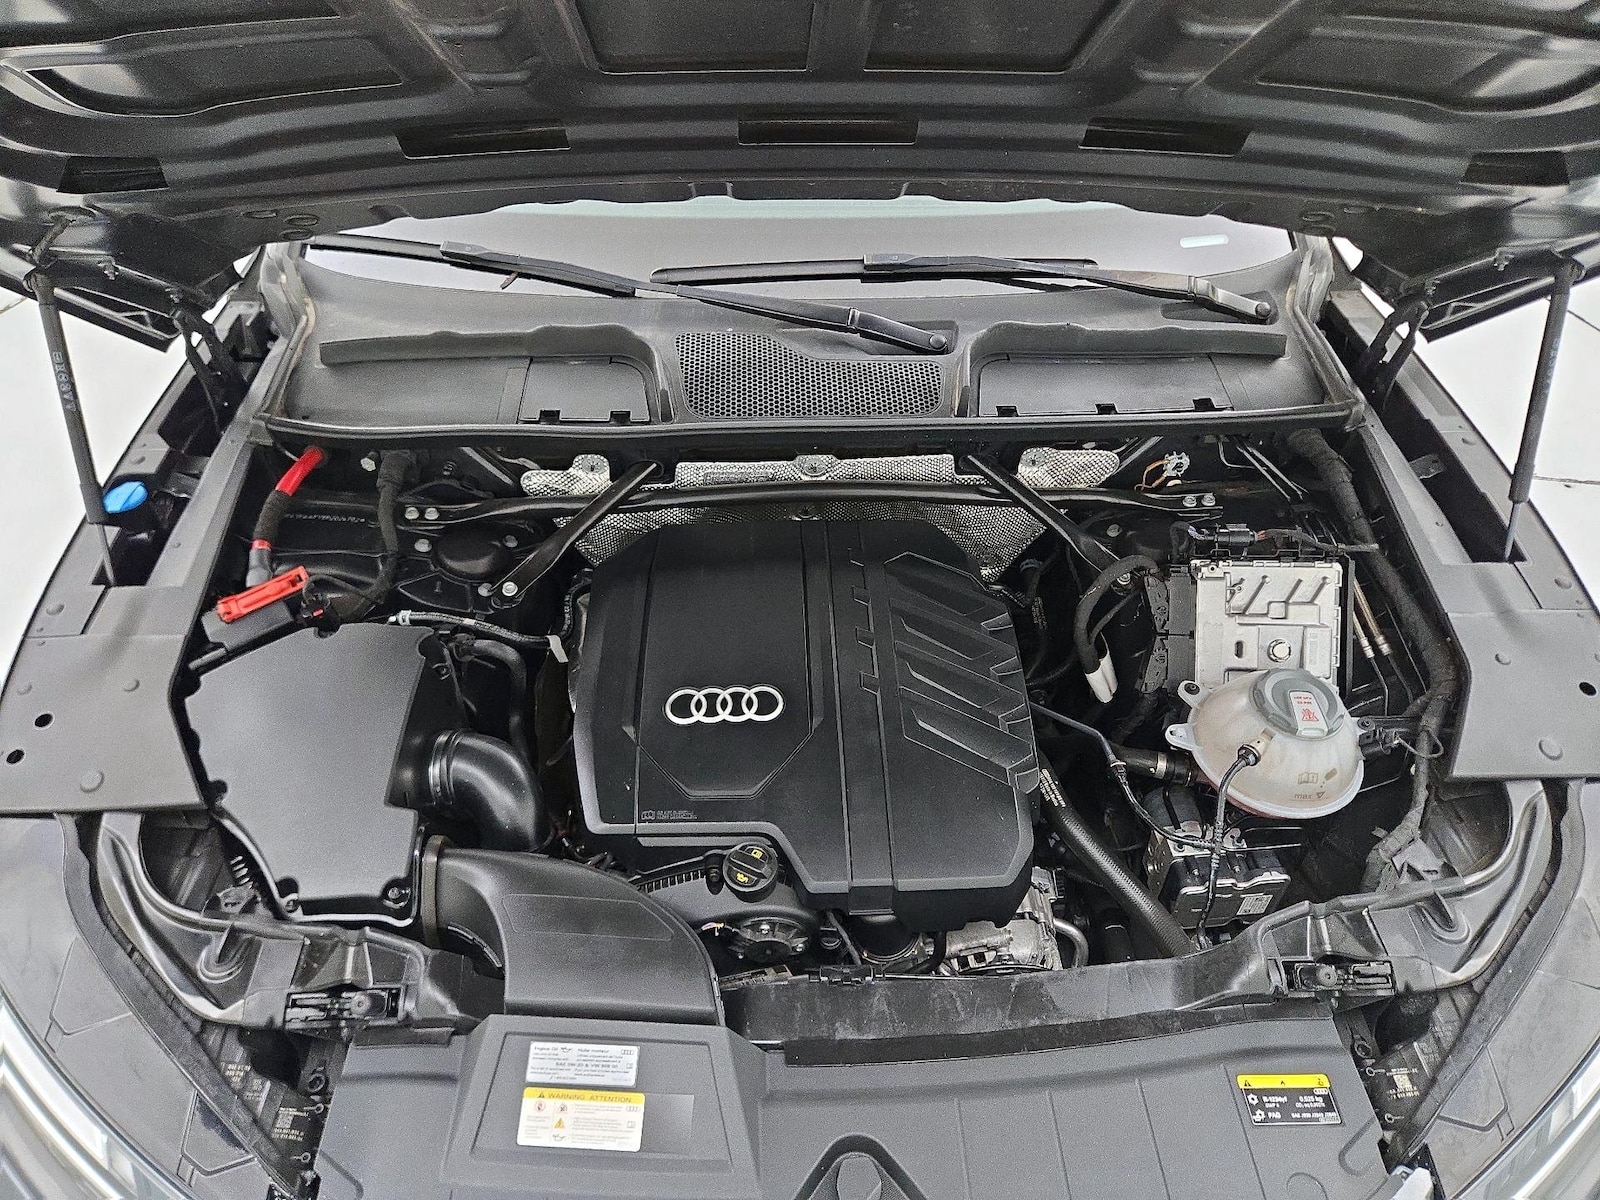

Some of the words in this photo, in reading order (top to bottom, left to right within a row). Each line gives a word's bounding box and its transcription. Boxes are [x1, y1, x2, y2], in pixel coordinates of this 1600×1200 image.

[548, 1092, 585, 1101] WARNING
[589, 1095, 632, 1104] ATTENTION
[1267, 1111, 1282, 1119] PAG
